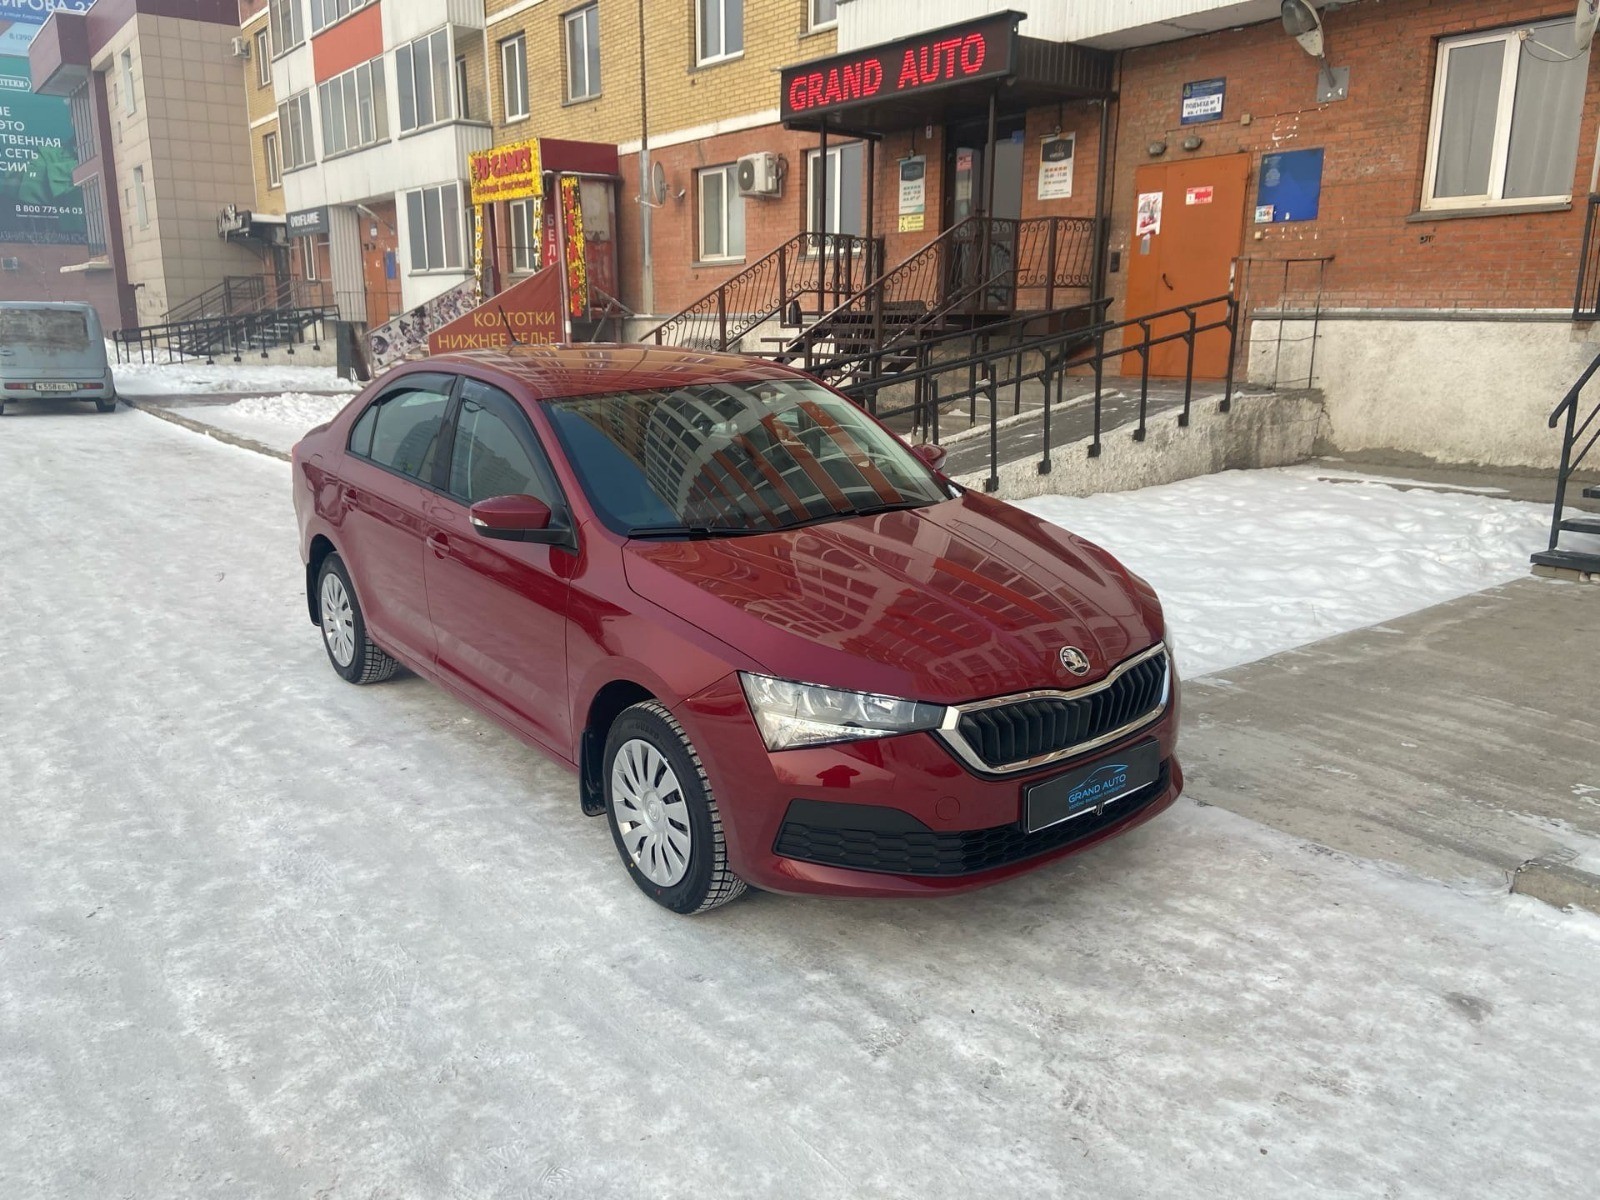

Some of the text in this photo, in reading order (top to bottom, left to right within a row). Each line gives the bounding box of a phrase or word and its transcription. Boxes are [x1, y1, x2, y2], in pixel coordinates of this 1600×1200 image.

[789, 33, 986, 111] GRAND AUTO
[5, 148, 39, 160] СЕТЬ
[15, 204, 83, 215] 8 800 775 64 03
[438, 332, 507, 349] НИЖНЕЕ
[1069, 773, 1127, 803] GRAND AUTO
